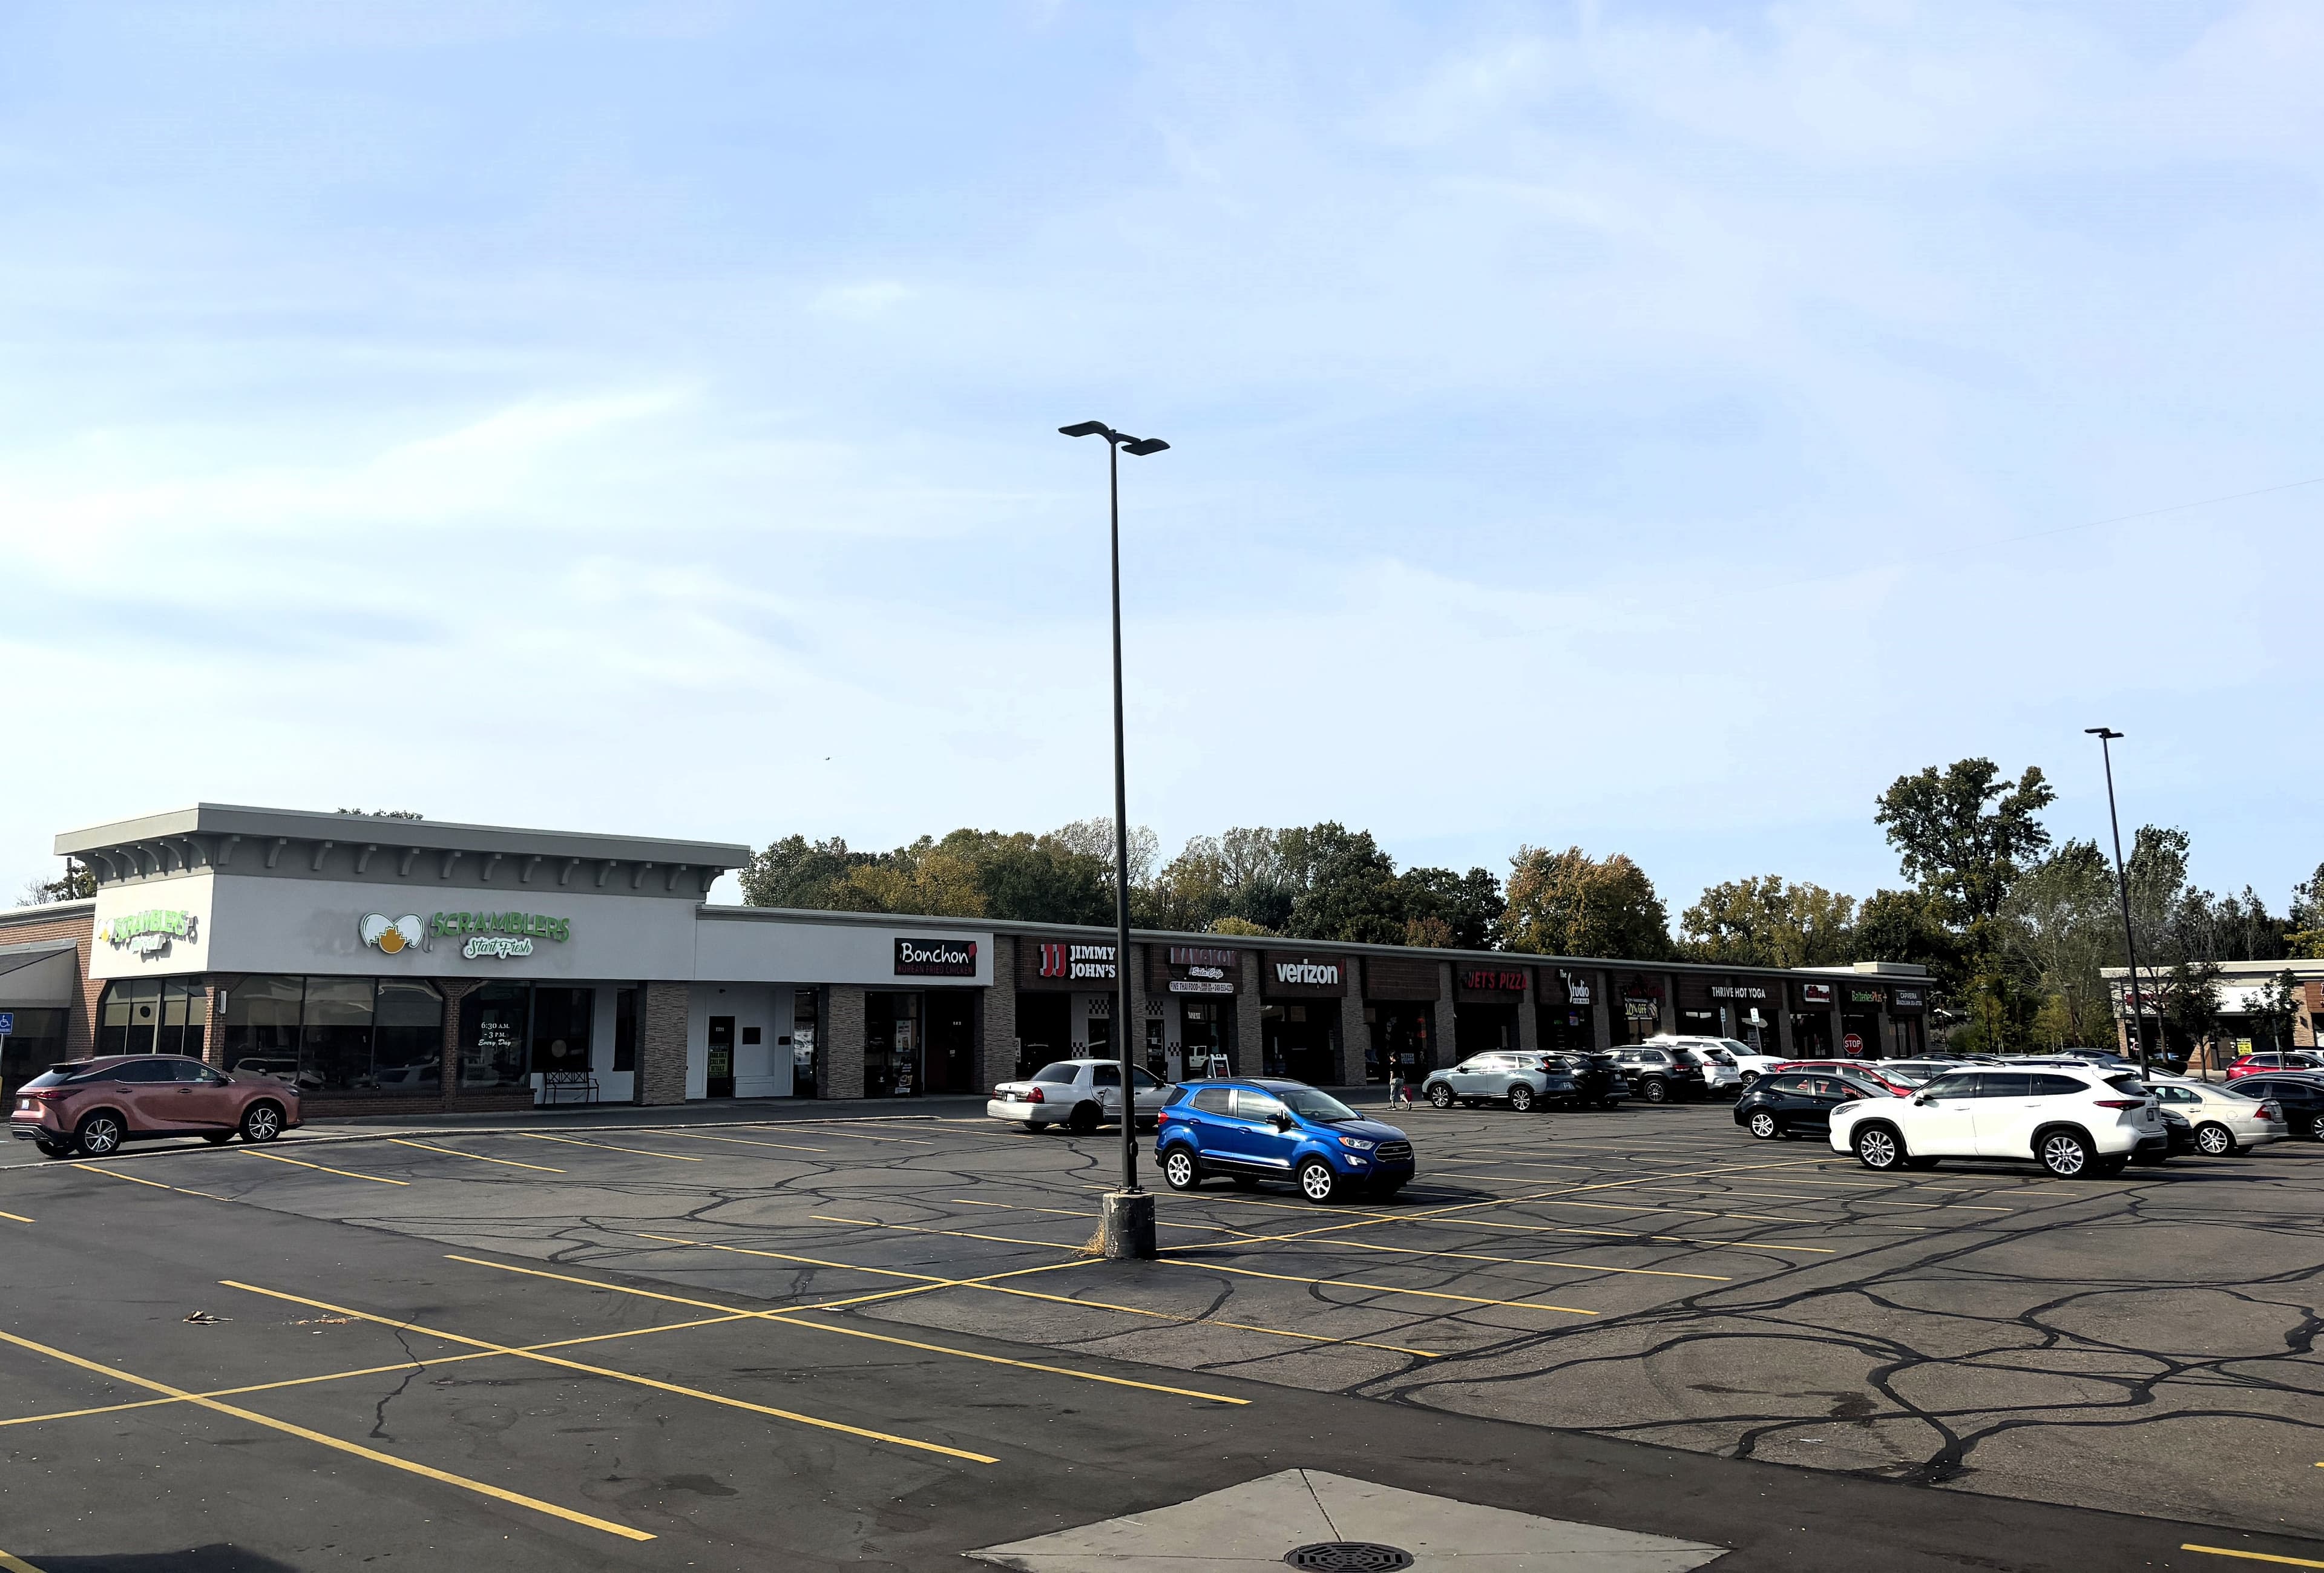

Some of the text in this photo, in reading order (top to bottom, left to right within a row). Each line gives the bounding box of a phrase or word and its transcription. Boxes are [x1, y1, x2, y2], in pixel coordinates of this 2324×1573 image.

[432, 911, 570, 943] SCRAMBLERS
[465, 939, 531, 956] Start Fresh
[901, 943, 968, 964] Bonchon
[1070, 945, 1115, 961] JIMMY
[1170, 947, 1235, 966] BANGKOK
[926, 965, 944, 974] FRIED
[1070, 963, 1115, 979] JOHN'S
[1276, 959, 1338, 984] verizon
[1468, 971, 1528, 990] JET'S PIZZA
[1567, 973, 1589, 1003] Studio
[1712, 987, 1765, 999] THRIVE HOT YOGA
[1638, 1003, 1646, 1014] OFF
